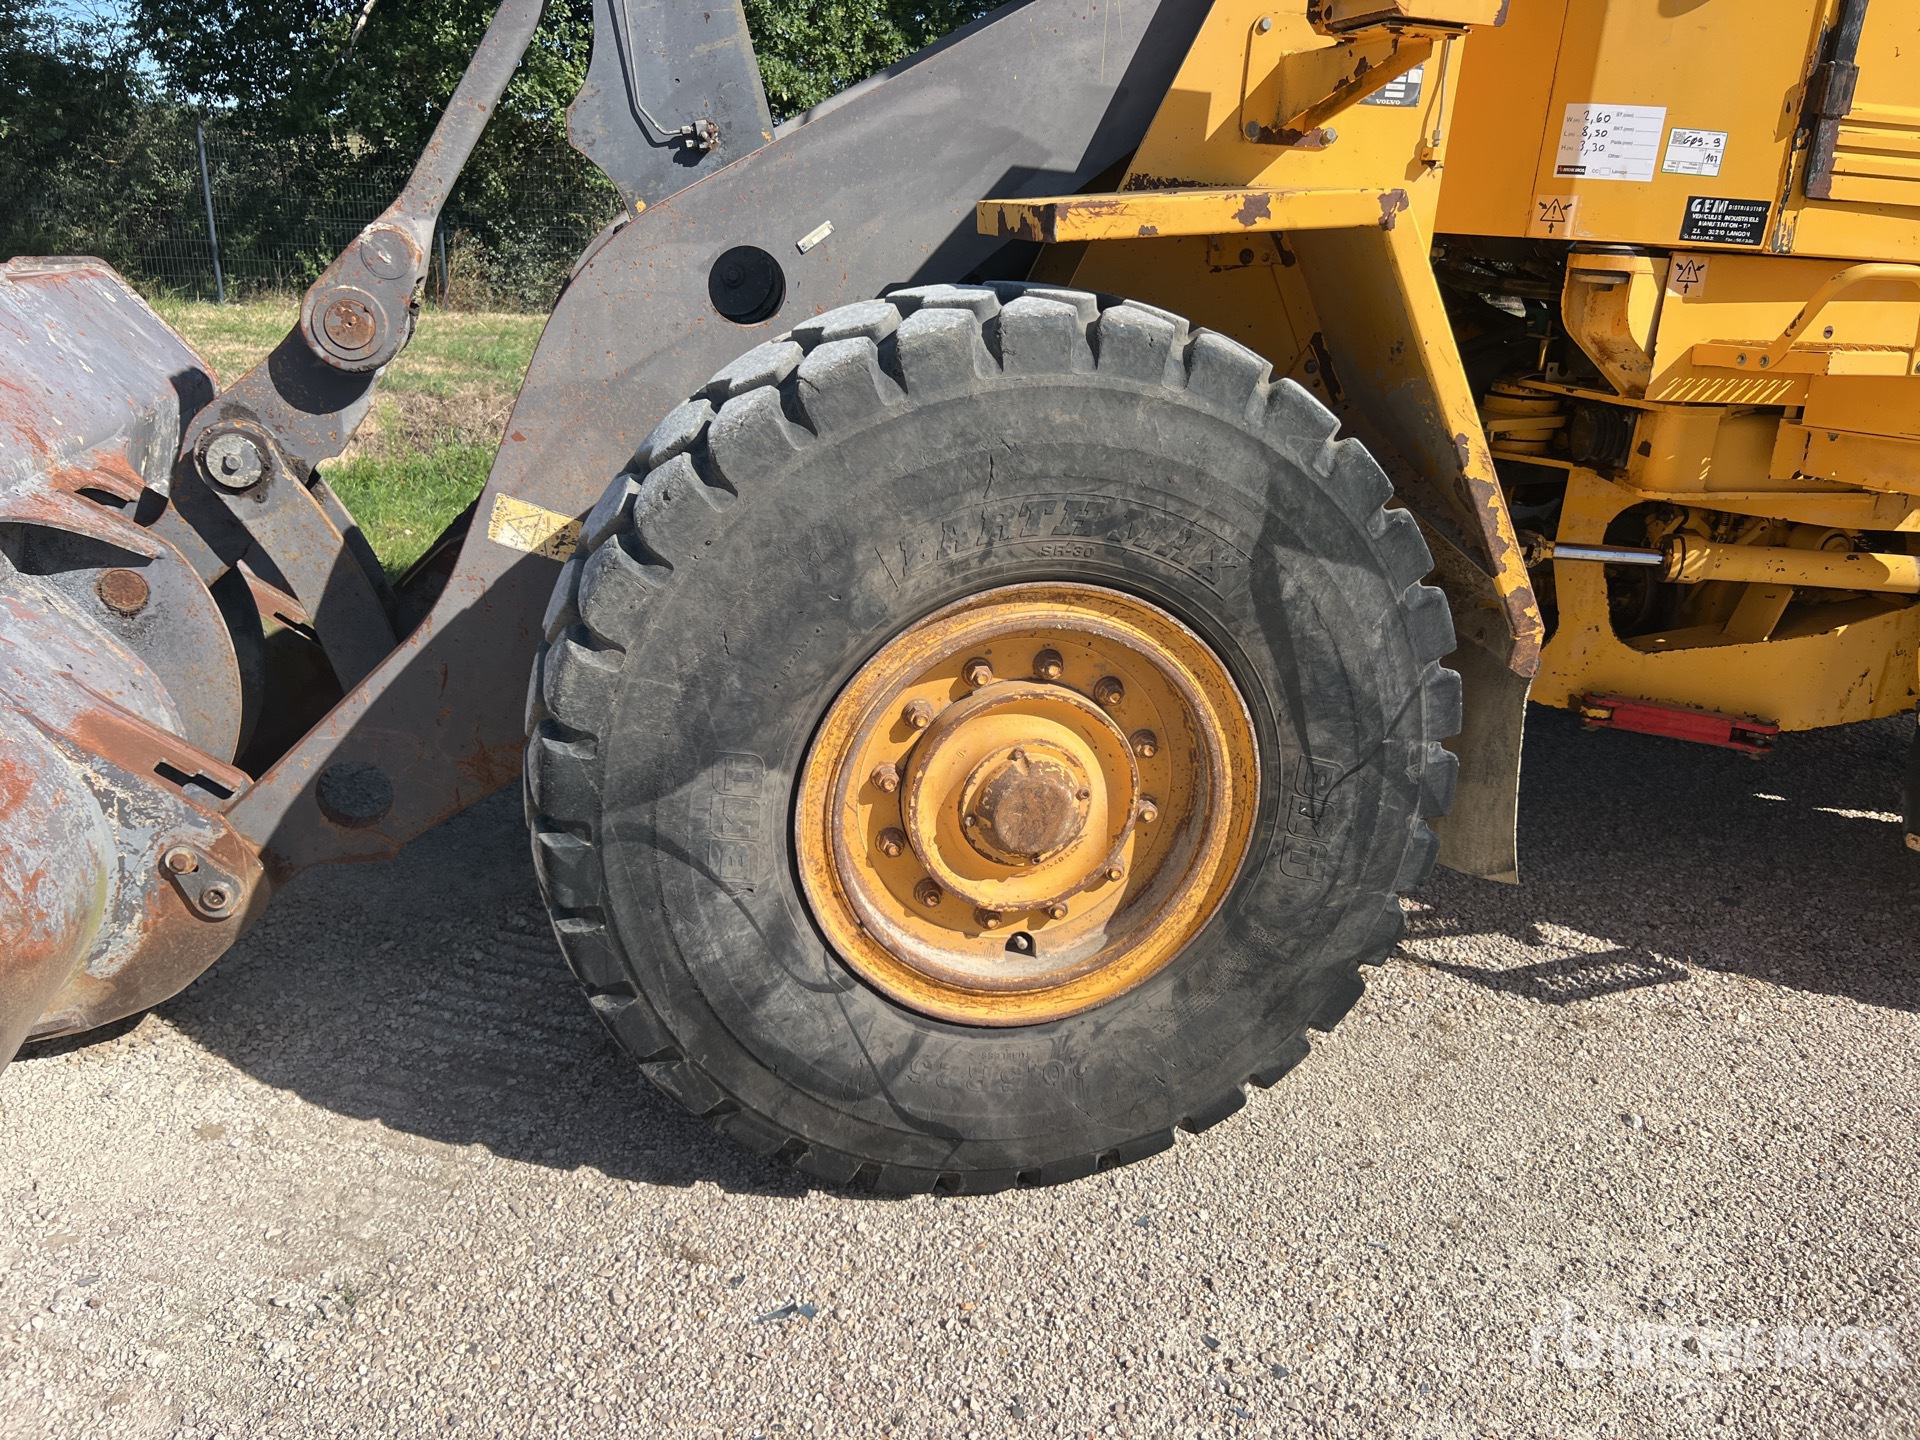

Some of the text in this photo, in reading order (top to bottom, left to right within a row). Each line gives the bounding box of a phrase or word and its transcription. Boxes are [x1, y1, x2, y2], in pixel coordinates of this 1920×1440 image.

[1584, 110, 1611, 124] 2,60
[1582, 126, 1608, 140] 8,50
[1580, 140, 1605, 156] 3,30
[1690, 199, 1729, 213] GEM
[1038, 544, 1097, 559] SR-30
